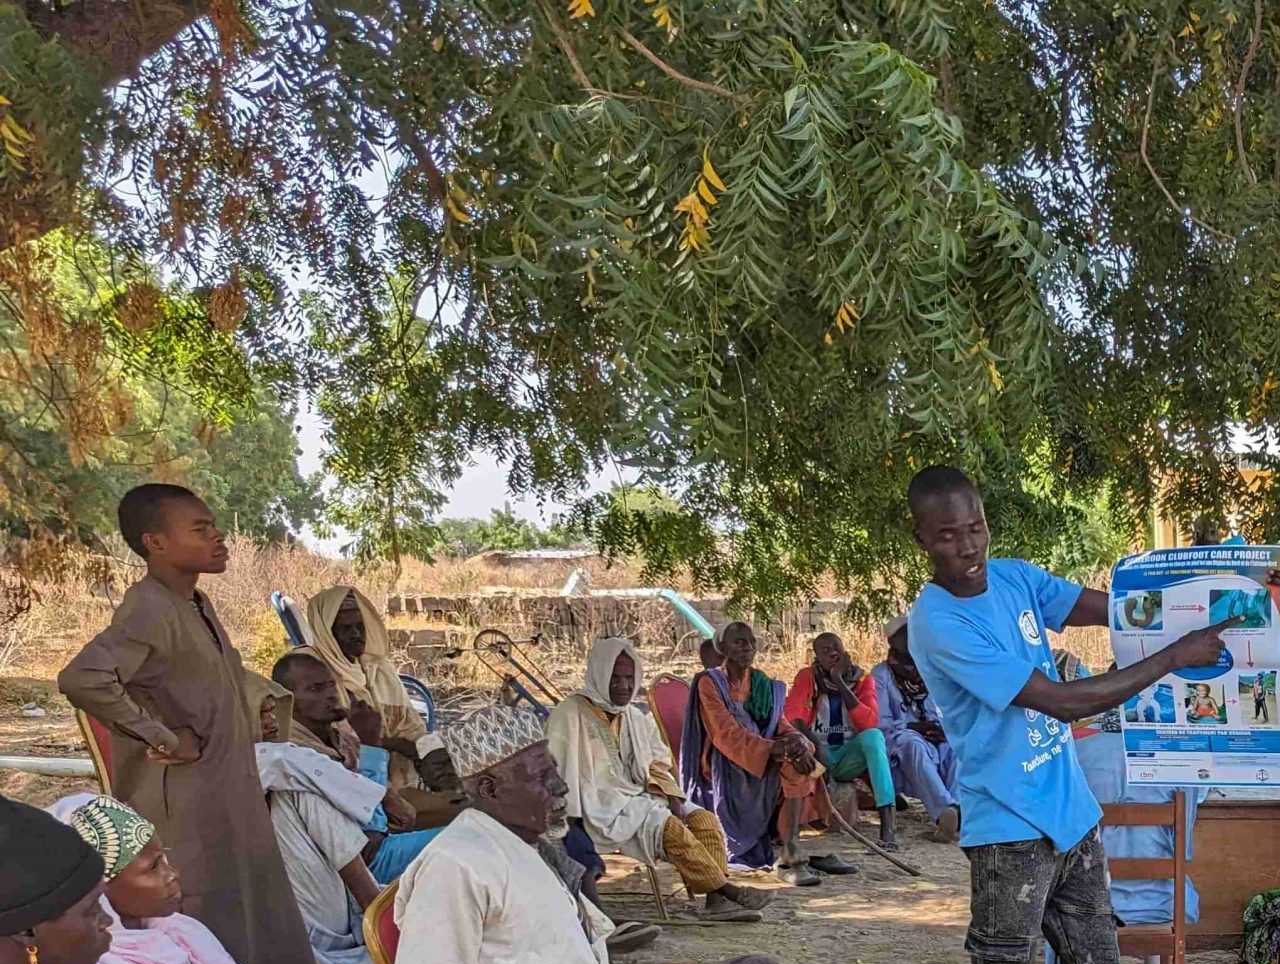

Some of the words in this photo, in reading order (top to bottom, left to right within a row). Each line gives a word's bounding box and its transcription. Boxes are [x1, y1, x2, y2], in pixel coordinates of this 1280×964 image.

[1168, 551, 1210, 561] CLUBFOOT
[1210, 550, 1233, 559] CARE
[1233, 550, 1271, 560] PROJECT
[1140, 770, 1154, 778] cbm
